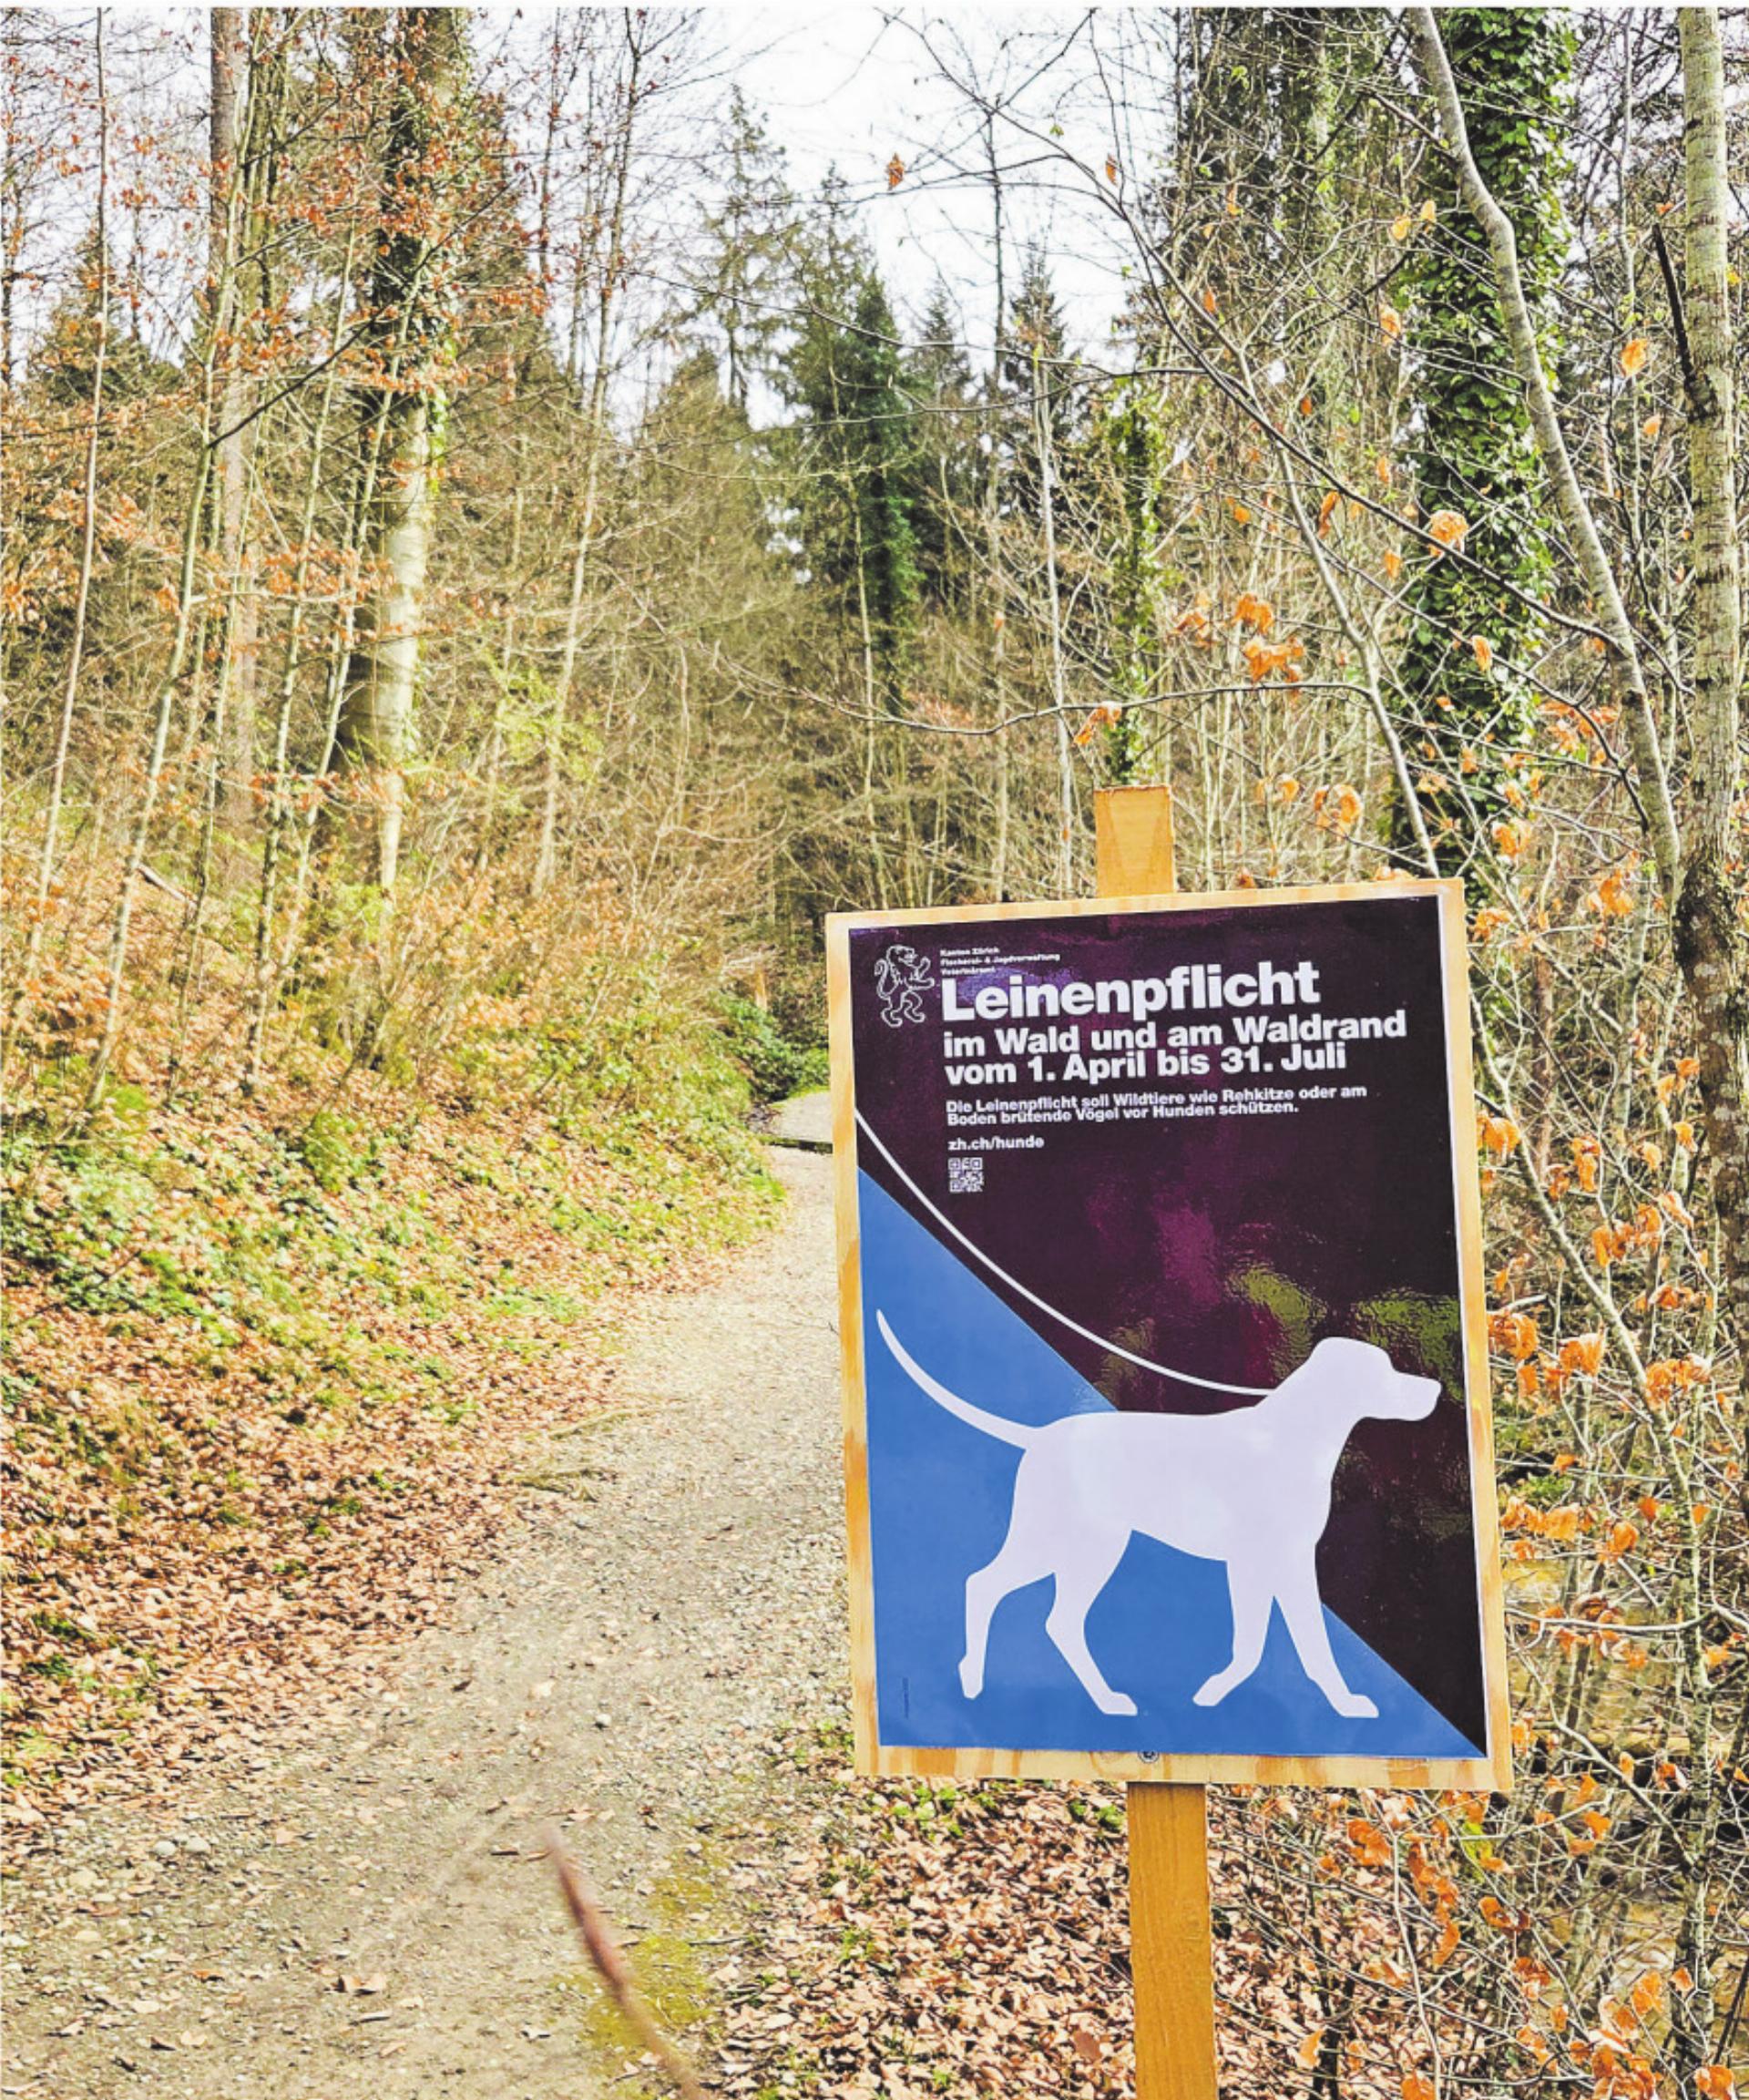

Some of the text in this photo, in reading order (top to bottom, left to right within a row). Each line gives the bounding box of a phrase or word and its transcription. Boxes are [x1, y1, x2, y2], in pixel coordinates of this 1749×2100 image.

[941, 961, 1321, 1021] Leinenpflicht
[944, 1009, 1407, 1058] im Wald und am Waldrand
[945, 1041, 1347, 1086] vom 1. April bis 31. Juli
[946, 1085, 1367, 1113] Die Leinenpflicht soll Wildtiere wie Rehkitze oder am
[947, 1100, 1300, 1126] Boden brütende Vögel vor Hunden schützen.
[947, 1135, 1045, 1152] zh.ch/hunde
